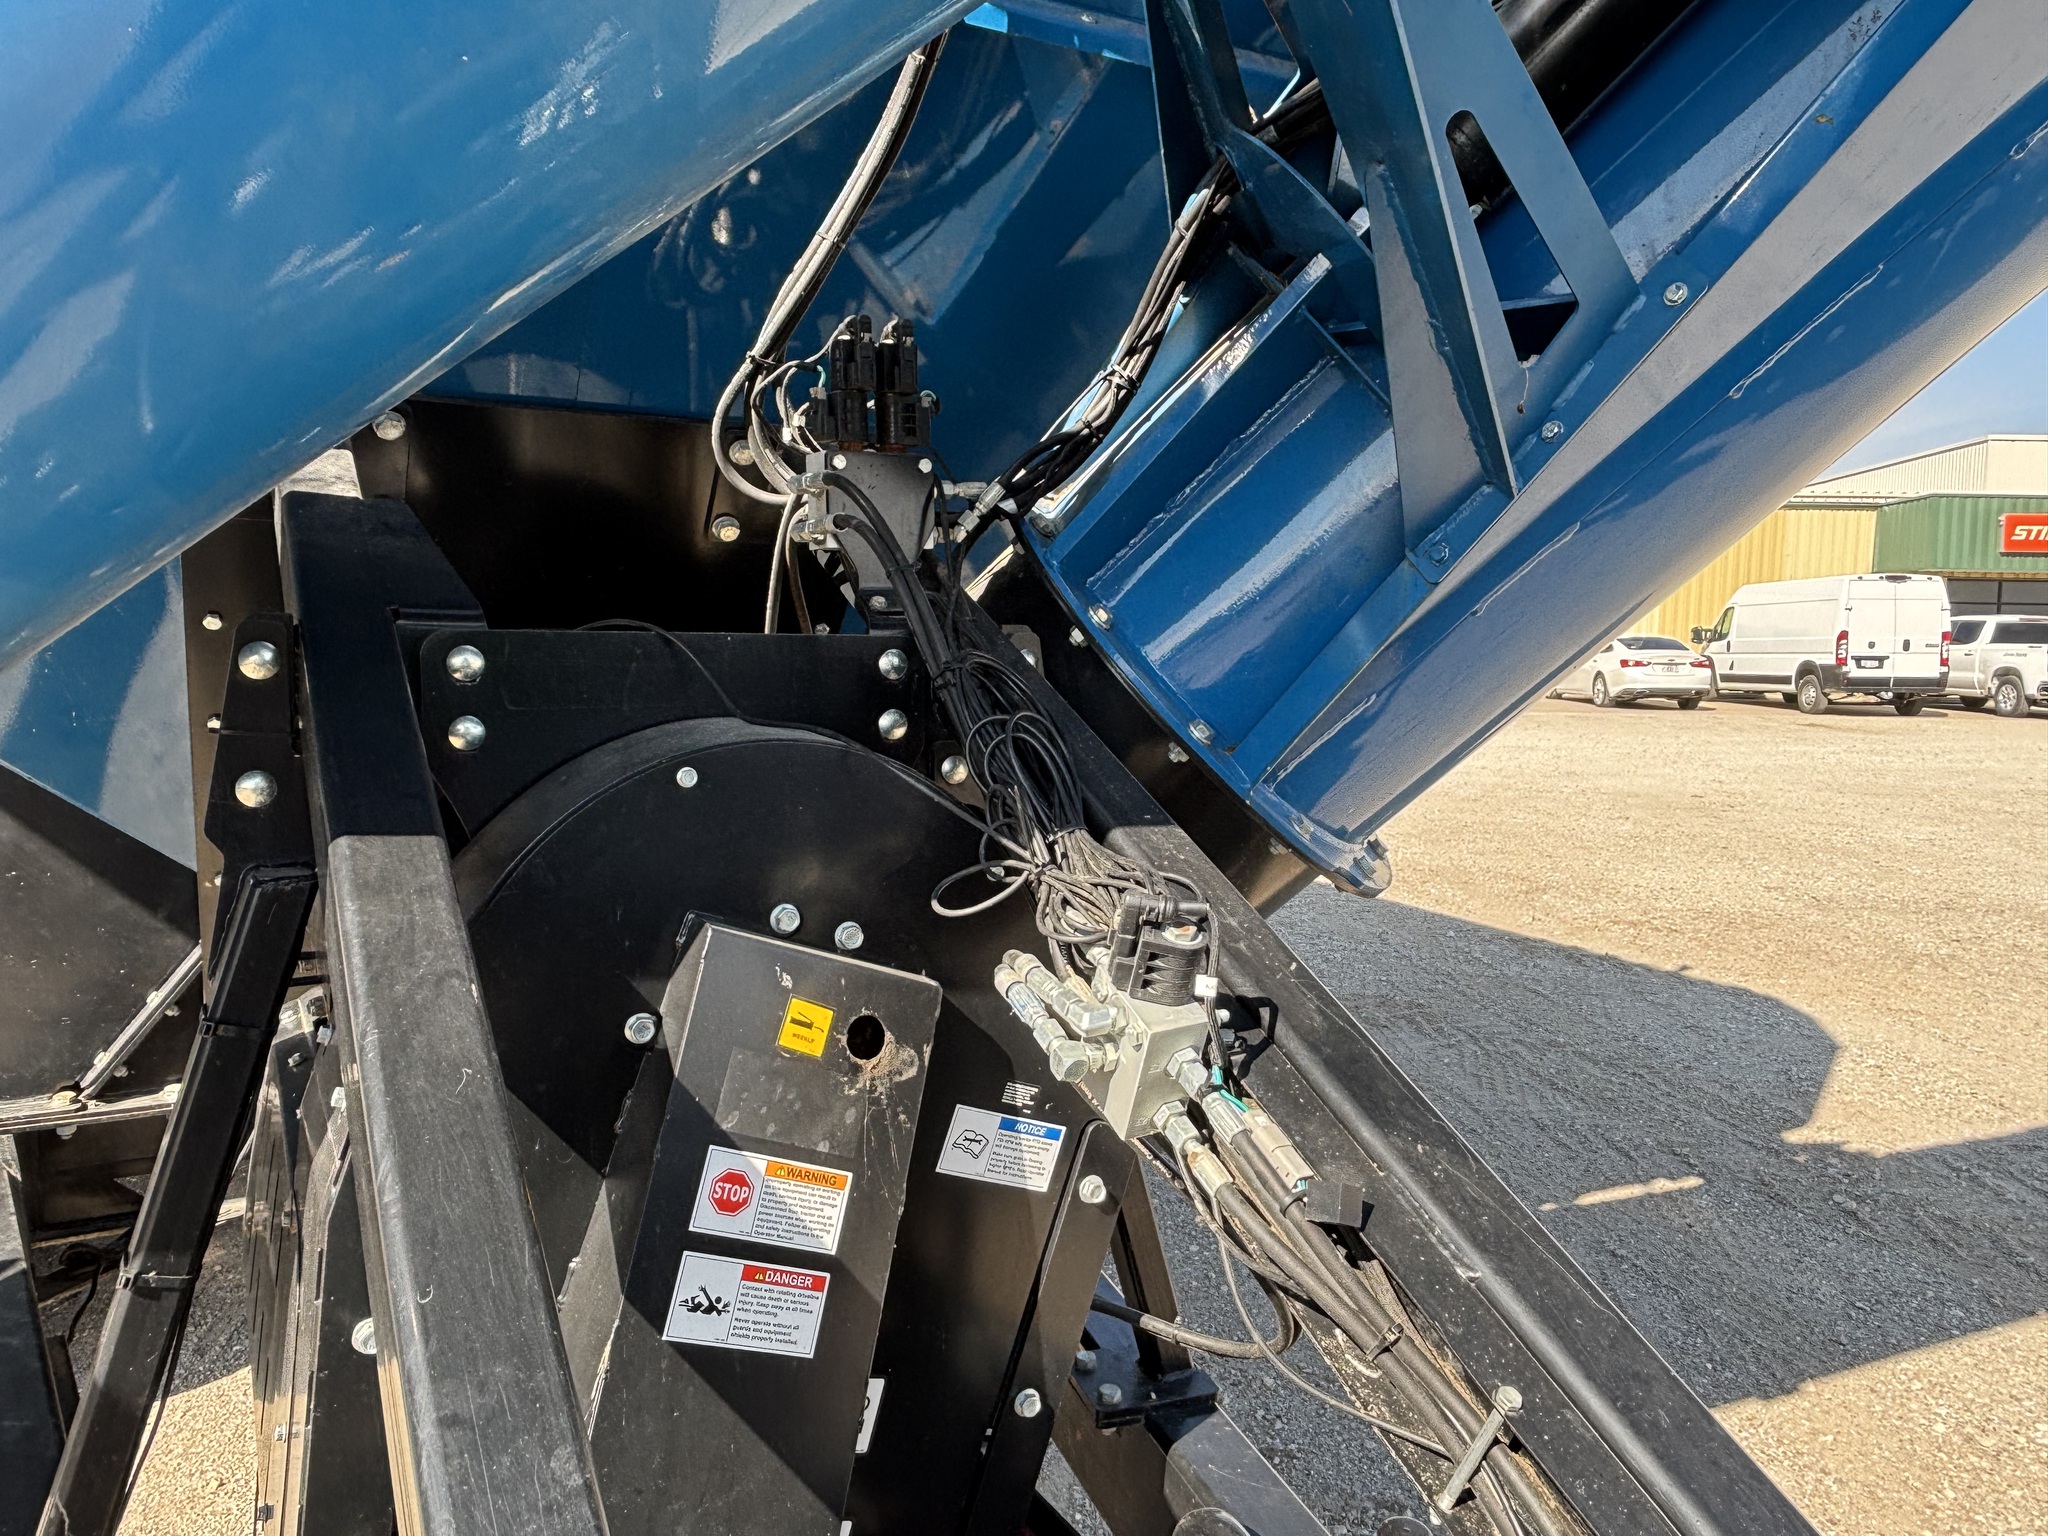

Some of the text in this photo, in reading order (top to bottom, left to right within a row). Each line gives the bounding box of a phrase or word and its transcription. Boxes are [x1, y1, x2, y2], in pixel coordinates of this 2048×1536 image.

[2010, 525, 2048, 540] STI
[1014, 1122, 1047, 1136] NOTICE
[786, 1167, 837, 1186] WARNING
[714, 1182, 749, 1203] STOP
[765, 1270, 813, 1288] DANGER
